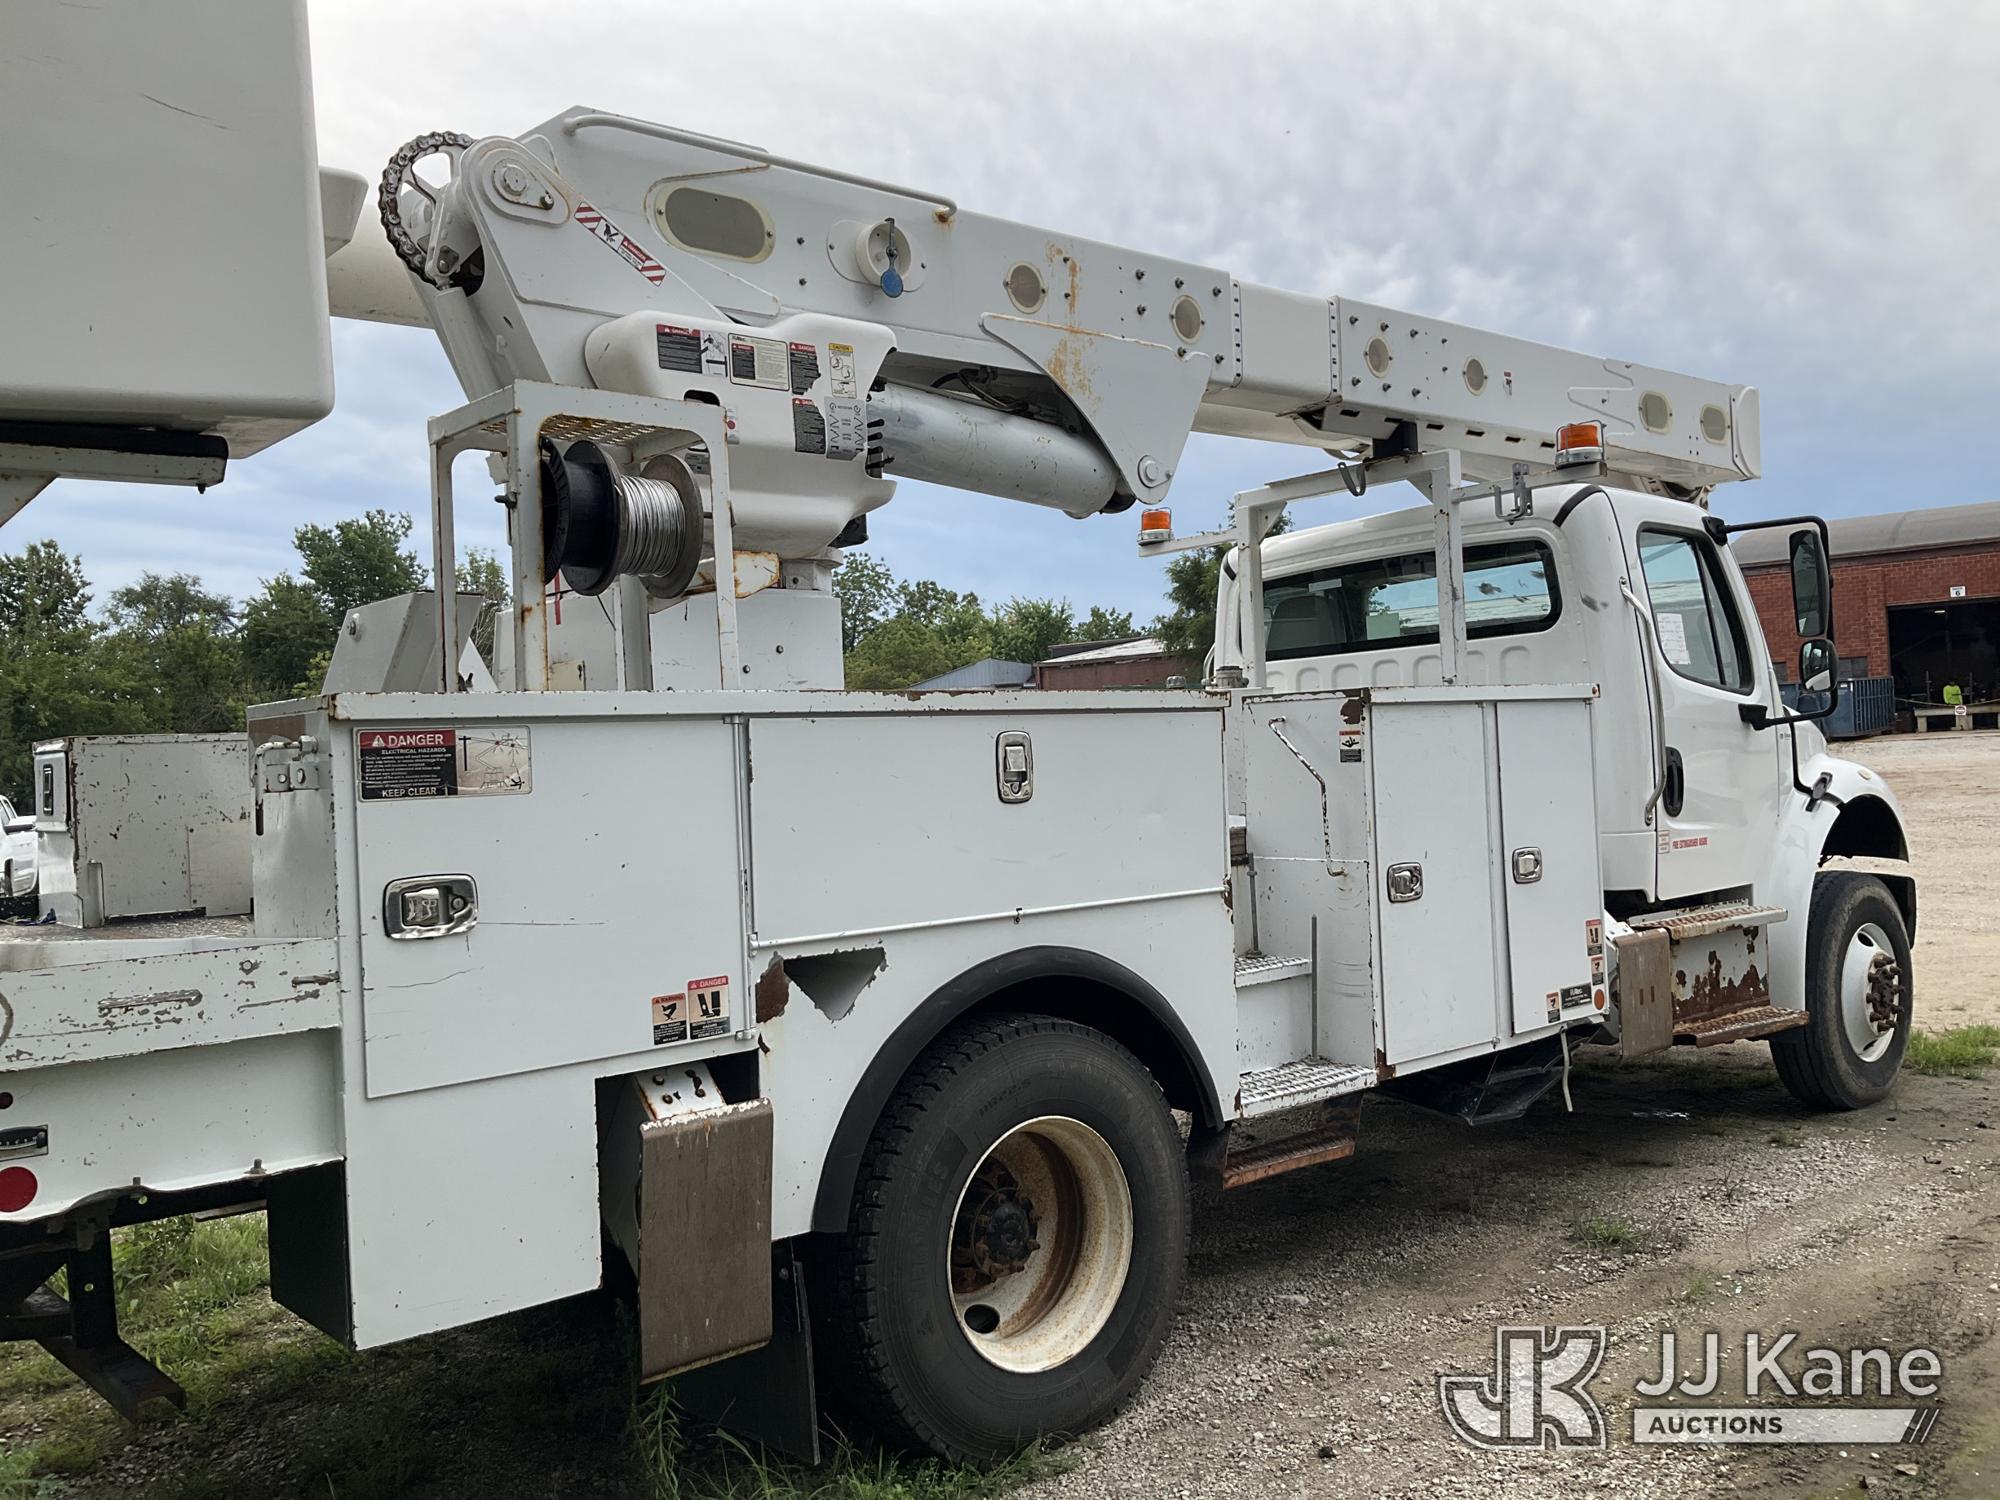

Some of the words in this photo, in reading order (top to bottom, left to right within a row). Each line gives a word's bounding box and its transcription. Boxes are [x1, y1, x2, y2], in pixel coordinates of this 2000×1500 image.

[388, 734, 444, 747] DANGER
[382, 788, 407, 798] KEEP
[407, 787, 437, 796] CLEAR
[700, 977, 726, 987] DANGER
